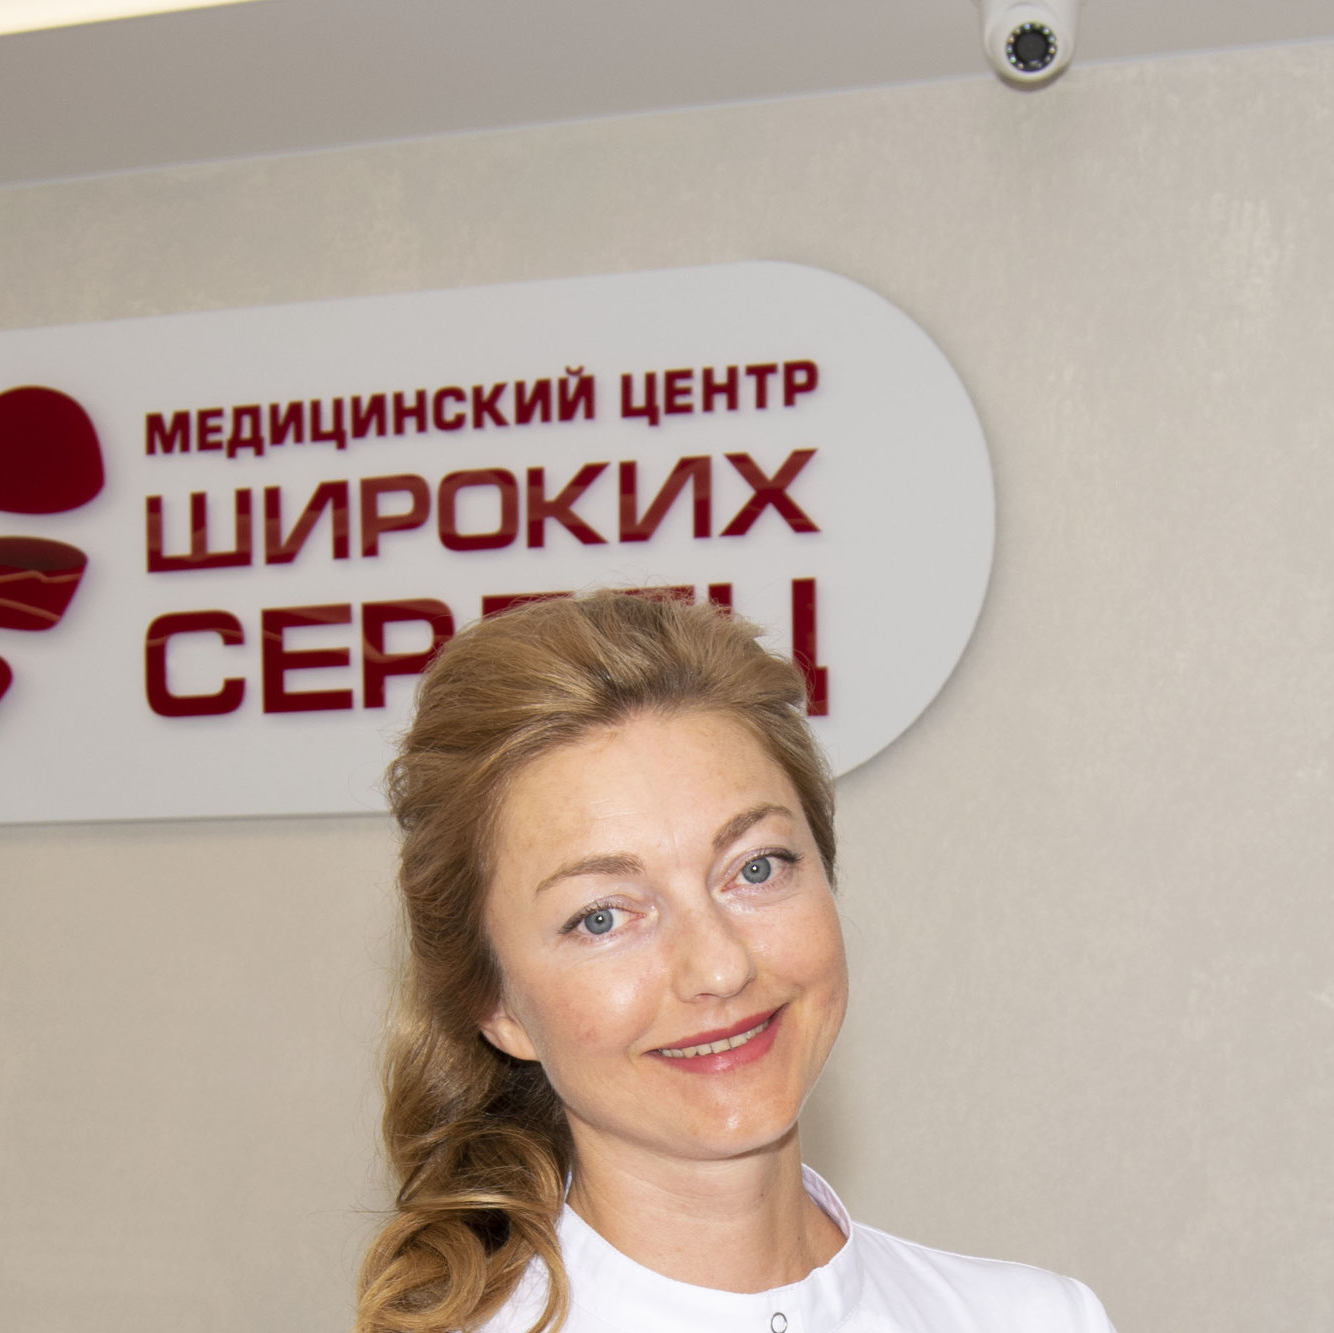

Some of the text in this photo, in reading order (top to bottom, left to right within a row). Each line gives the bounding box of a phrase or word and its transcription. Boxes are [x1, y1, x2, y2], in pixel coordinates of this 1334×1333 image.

[145, 360, 819, 459] МЕДИЦИНСКИЙ ЦЕНТР
[146, 449, 821, 573] ШИРОКИХ
